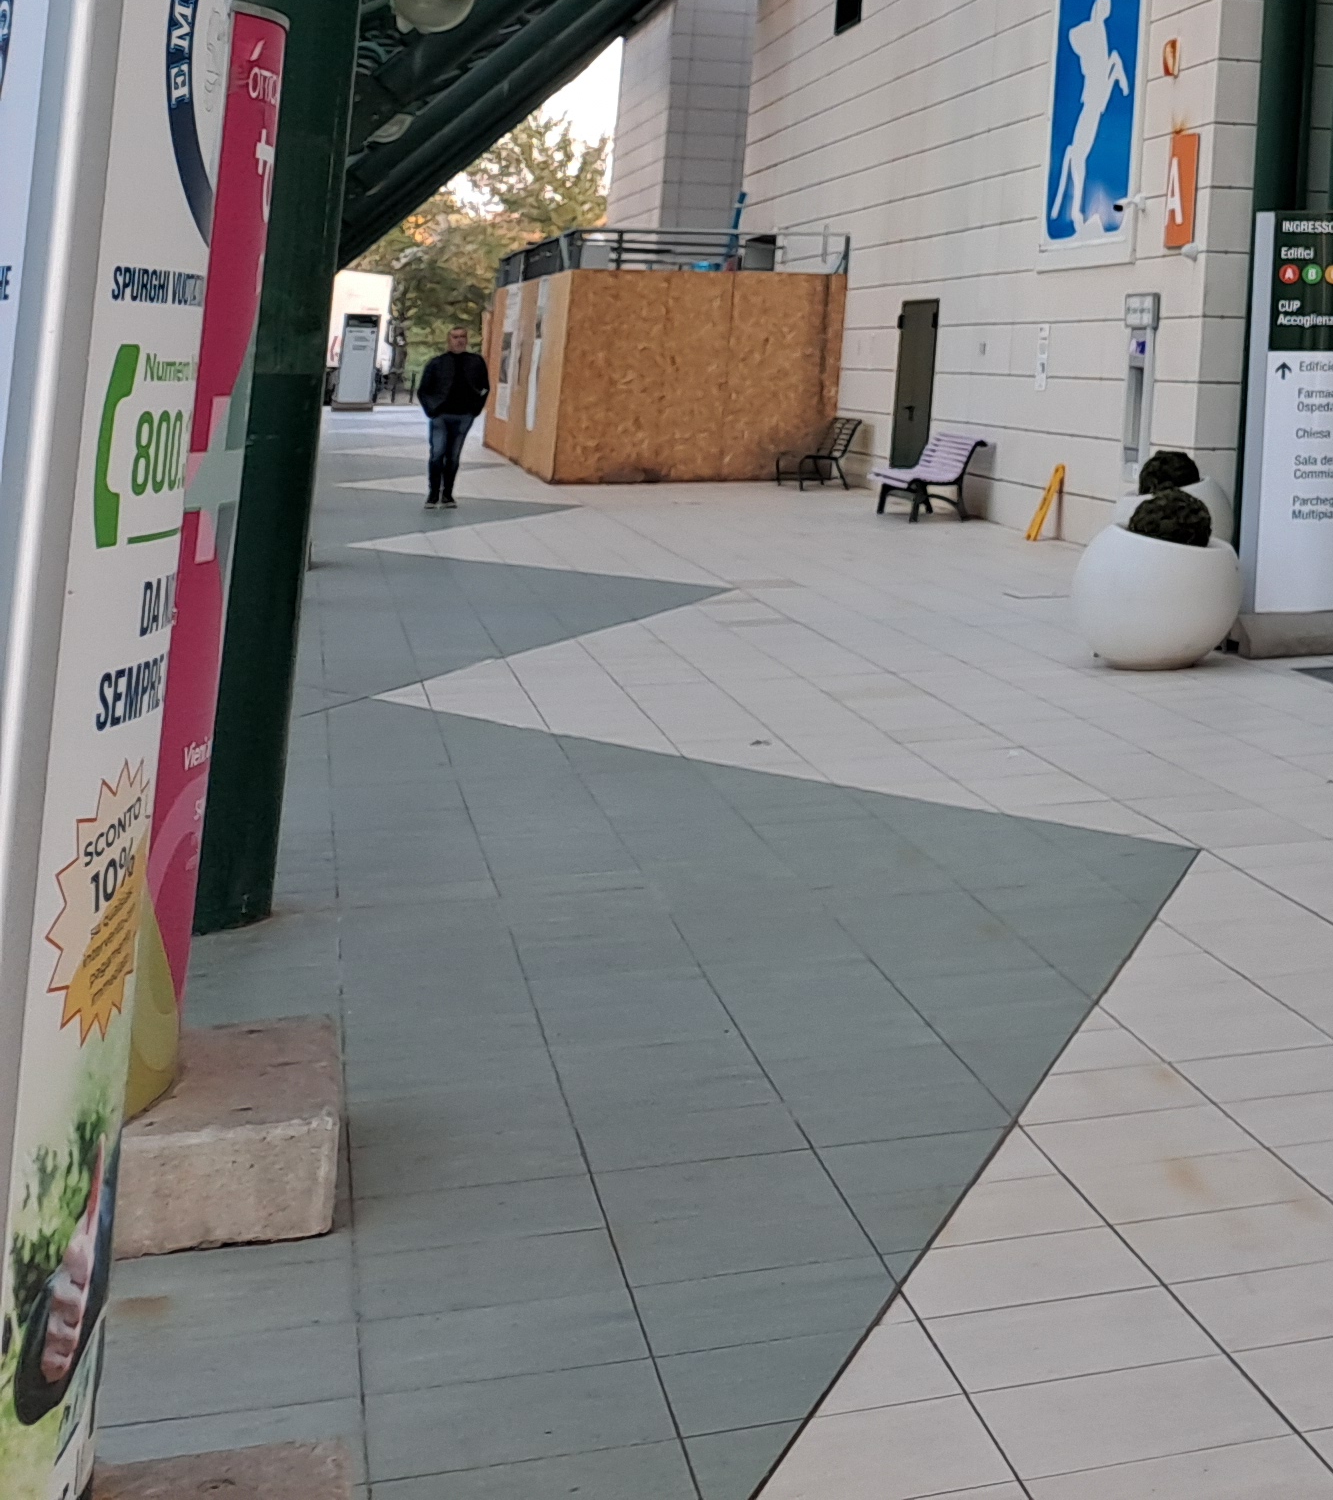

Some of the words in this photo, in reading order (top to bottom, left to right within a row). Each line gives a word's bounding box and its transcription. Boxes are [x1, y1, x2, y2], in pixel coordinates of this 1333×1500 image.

[1164, 156, 1184, 226] A
[1280, 247, 1314, 260] Edifici
[111, 265, 170, 304] SPURGHI
[1278, 299, 1301, 312] CUP
[1295, 428, 1331, 439] Chiesa
[1294, 454, 1318, 466] Sala
[96, 653, 165, 732] SEMPRE
[84, 796, 142, 868] SCONTO
[90, 836, 135, 915] 10%
